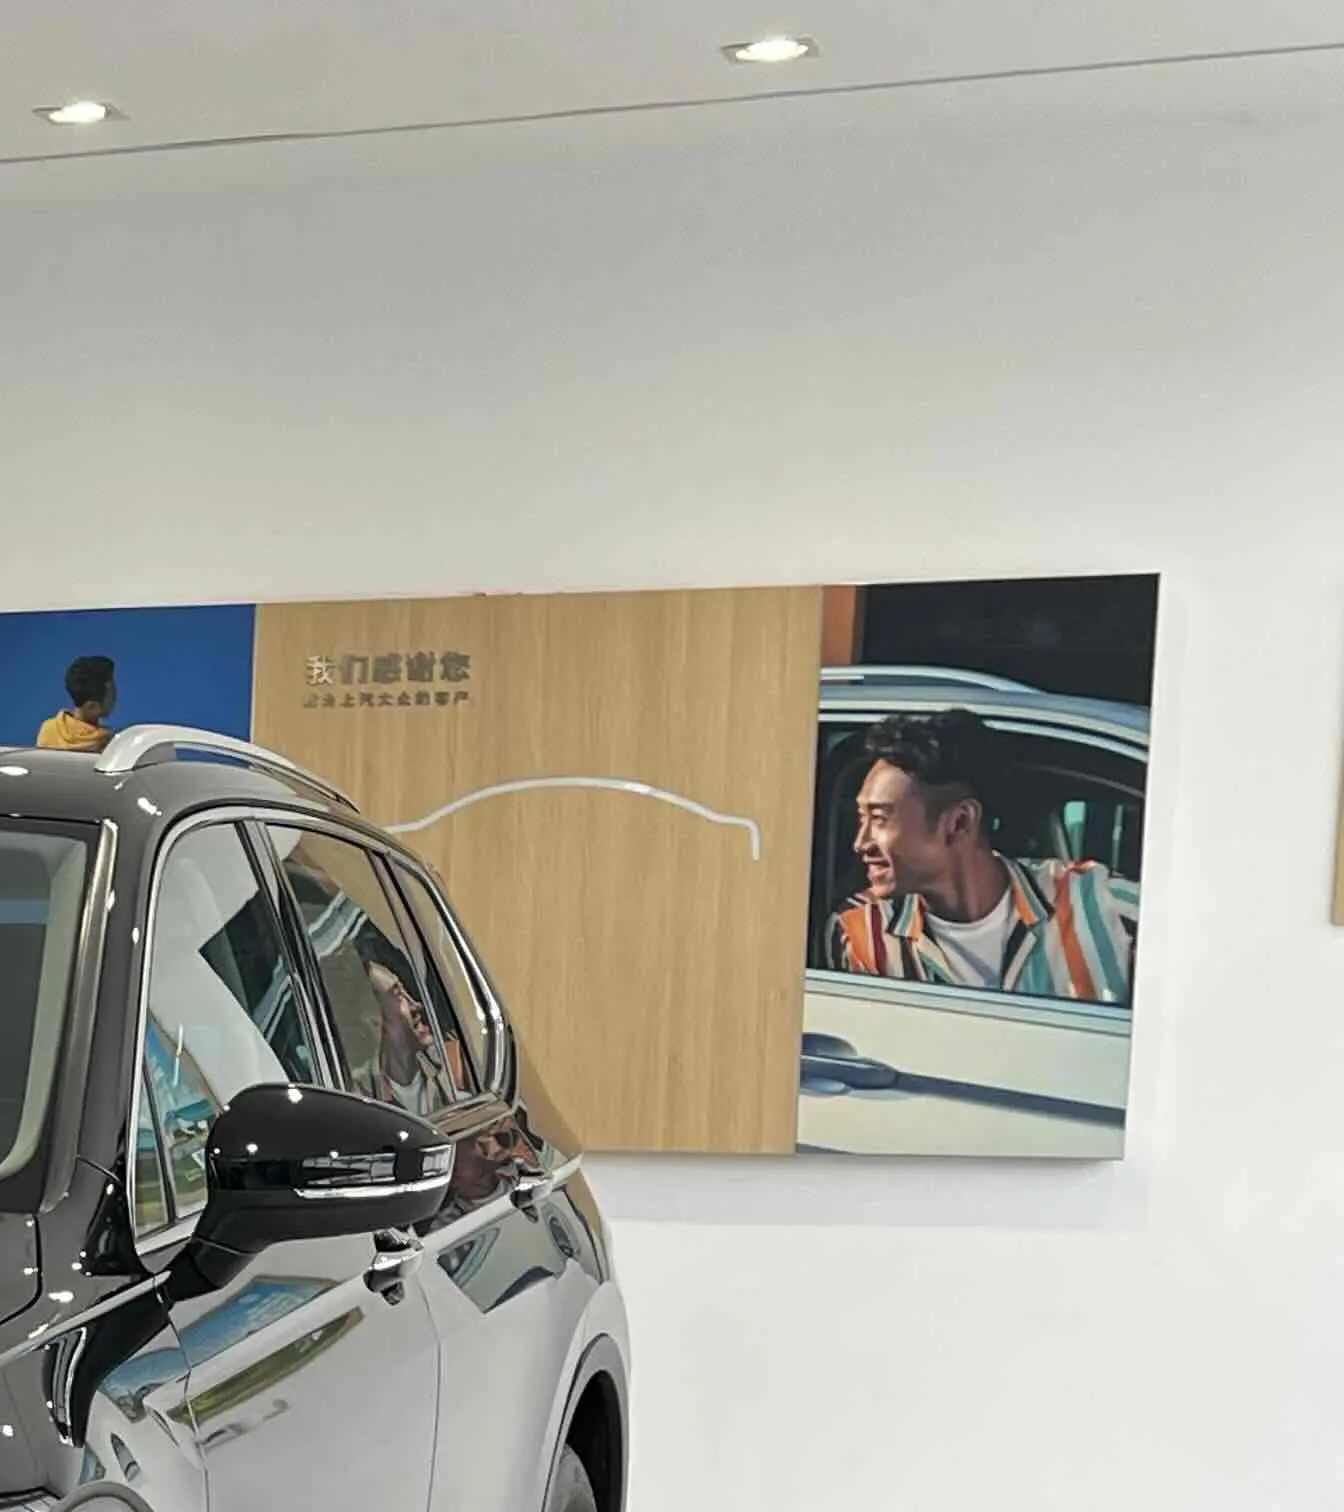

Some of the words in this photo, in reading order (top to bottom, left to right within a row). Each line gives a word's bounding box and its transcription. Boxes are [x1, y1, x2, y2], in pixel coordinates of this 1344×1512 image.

[304, 651, 471, 687] 我们感谢您
